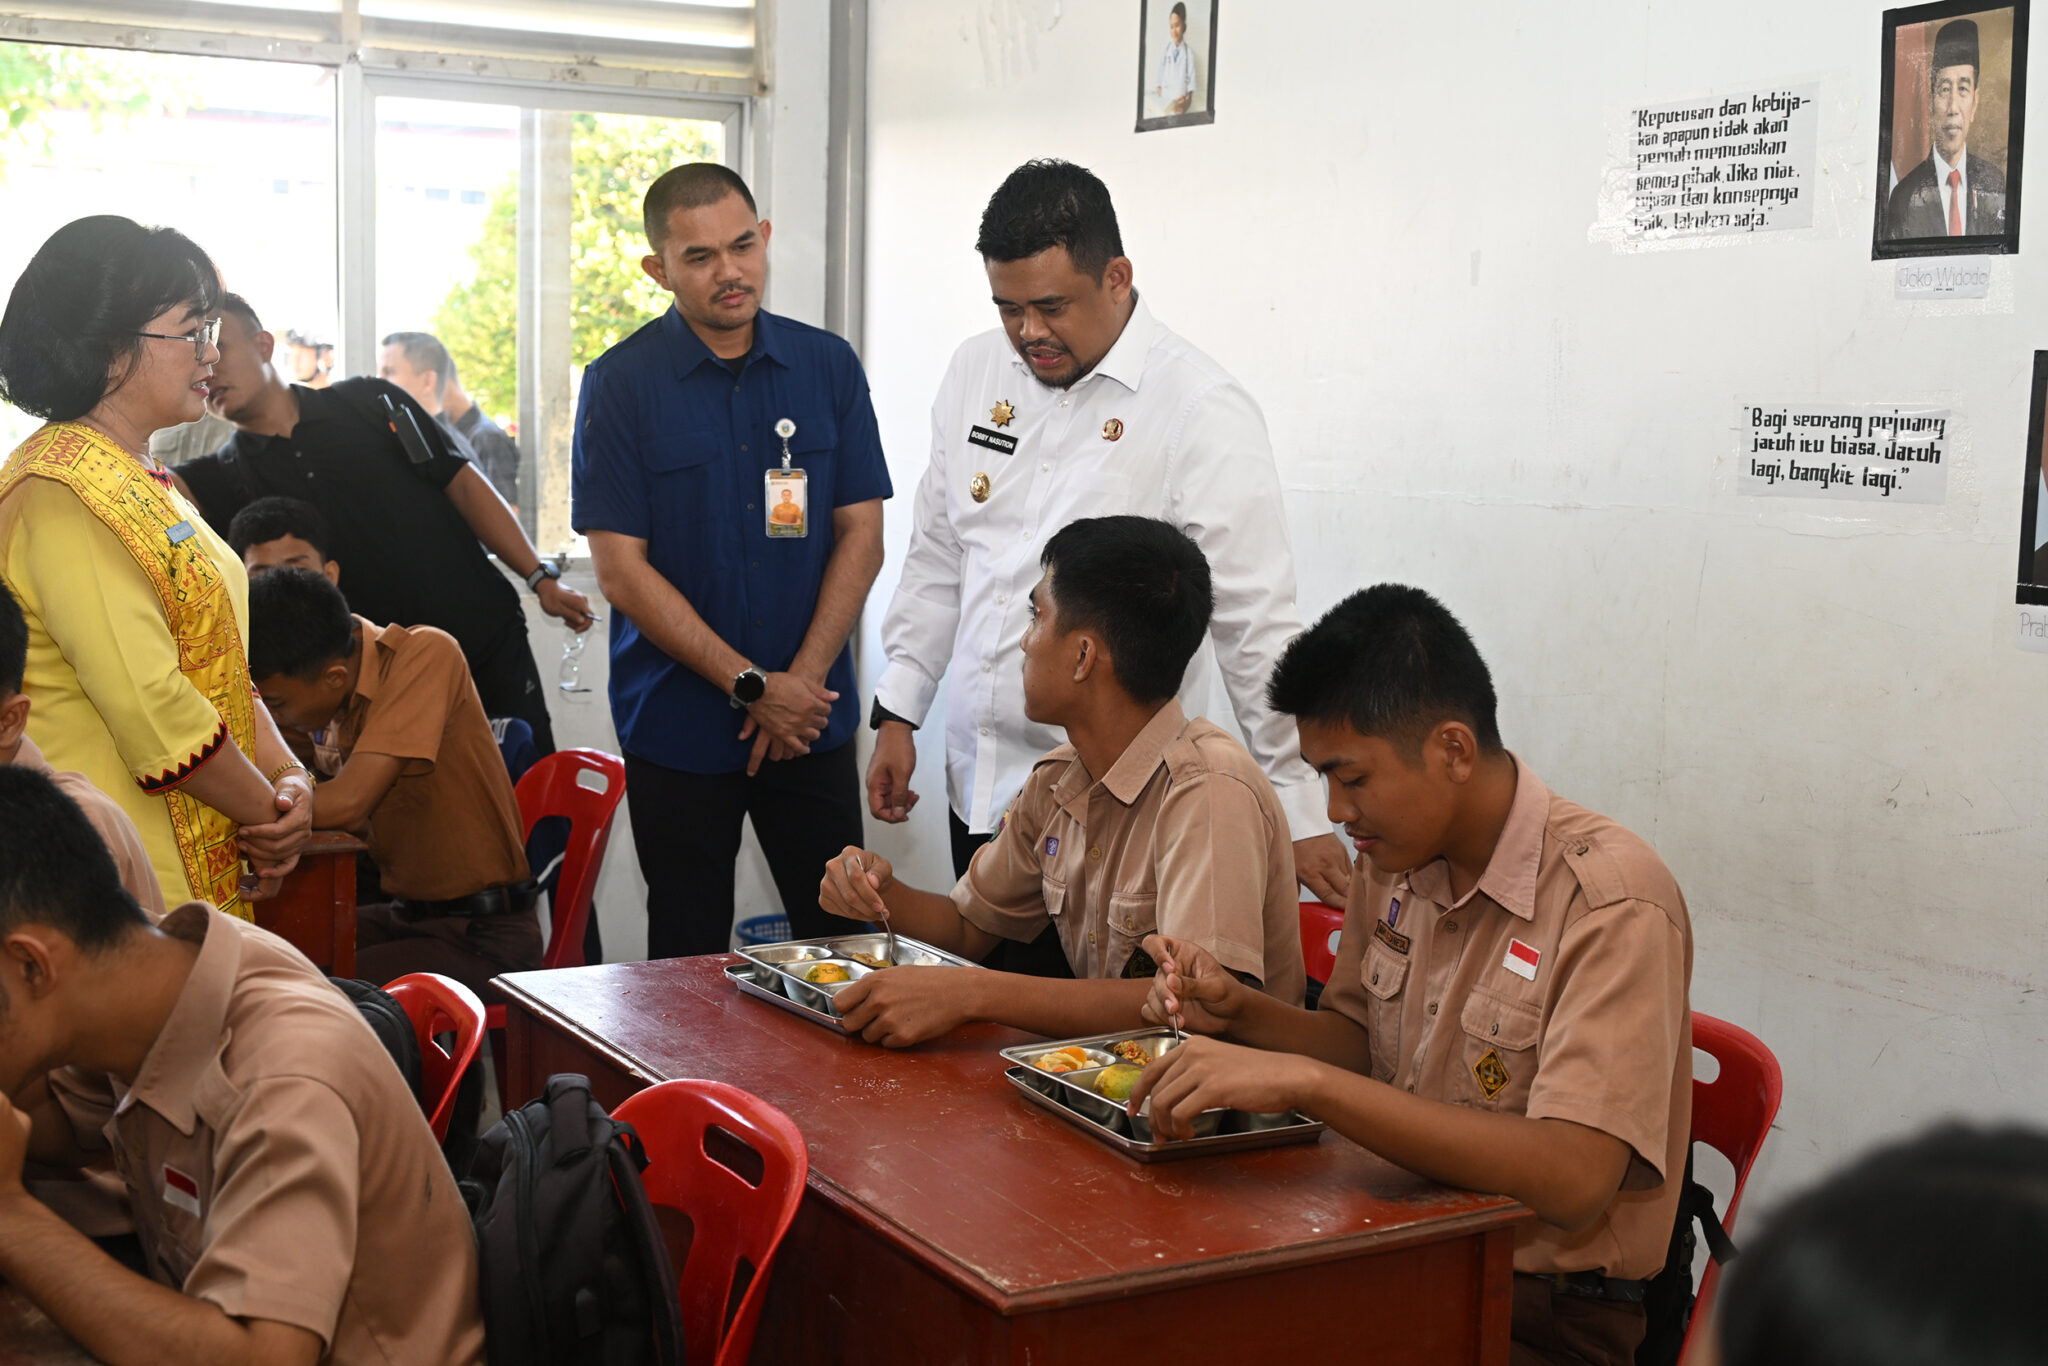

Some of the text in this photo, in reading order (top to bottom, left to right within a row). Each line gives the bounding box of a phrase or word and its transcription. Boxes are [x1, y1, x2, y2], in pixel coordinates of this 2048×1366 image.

[1718, 99, 1747, 117] dan
[1752, 91, 1811, 118] kebija-
[1637, 117, 1789, 148] kan apapun tidak akan
[1637, 138, 1787, 171] pernah memuaskan
[1636, 174, 1679, 191] semua
[1726, 163, 1758, 182] Jika
[1681, 187, 1709, 207] dan
[1713, 186, 1799, 206] konsepnya
[1674, 211, 1730, 230] lakukan
[1899, 266, 1988, 288] Joko Widodo
[1793, 414, 1863, 438] seorang
[1868, 409, 1946, 440] pejuang
[1751, 431, 1941, 464] jatuh itu biasa. Jatuh
[1751, 458, 1785, 485] lagi,
[1789, 459, 1855, 490] bangkit
